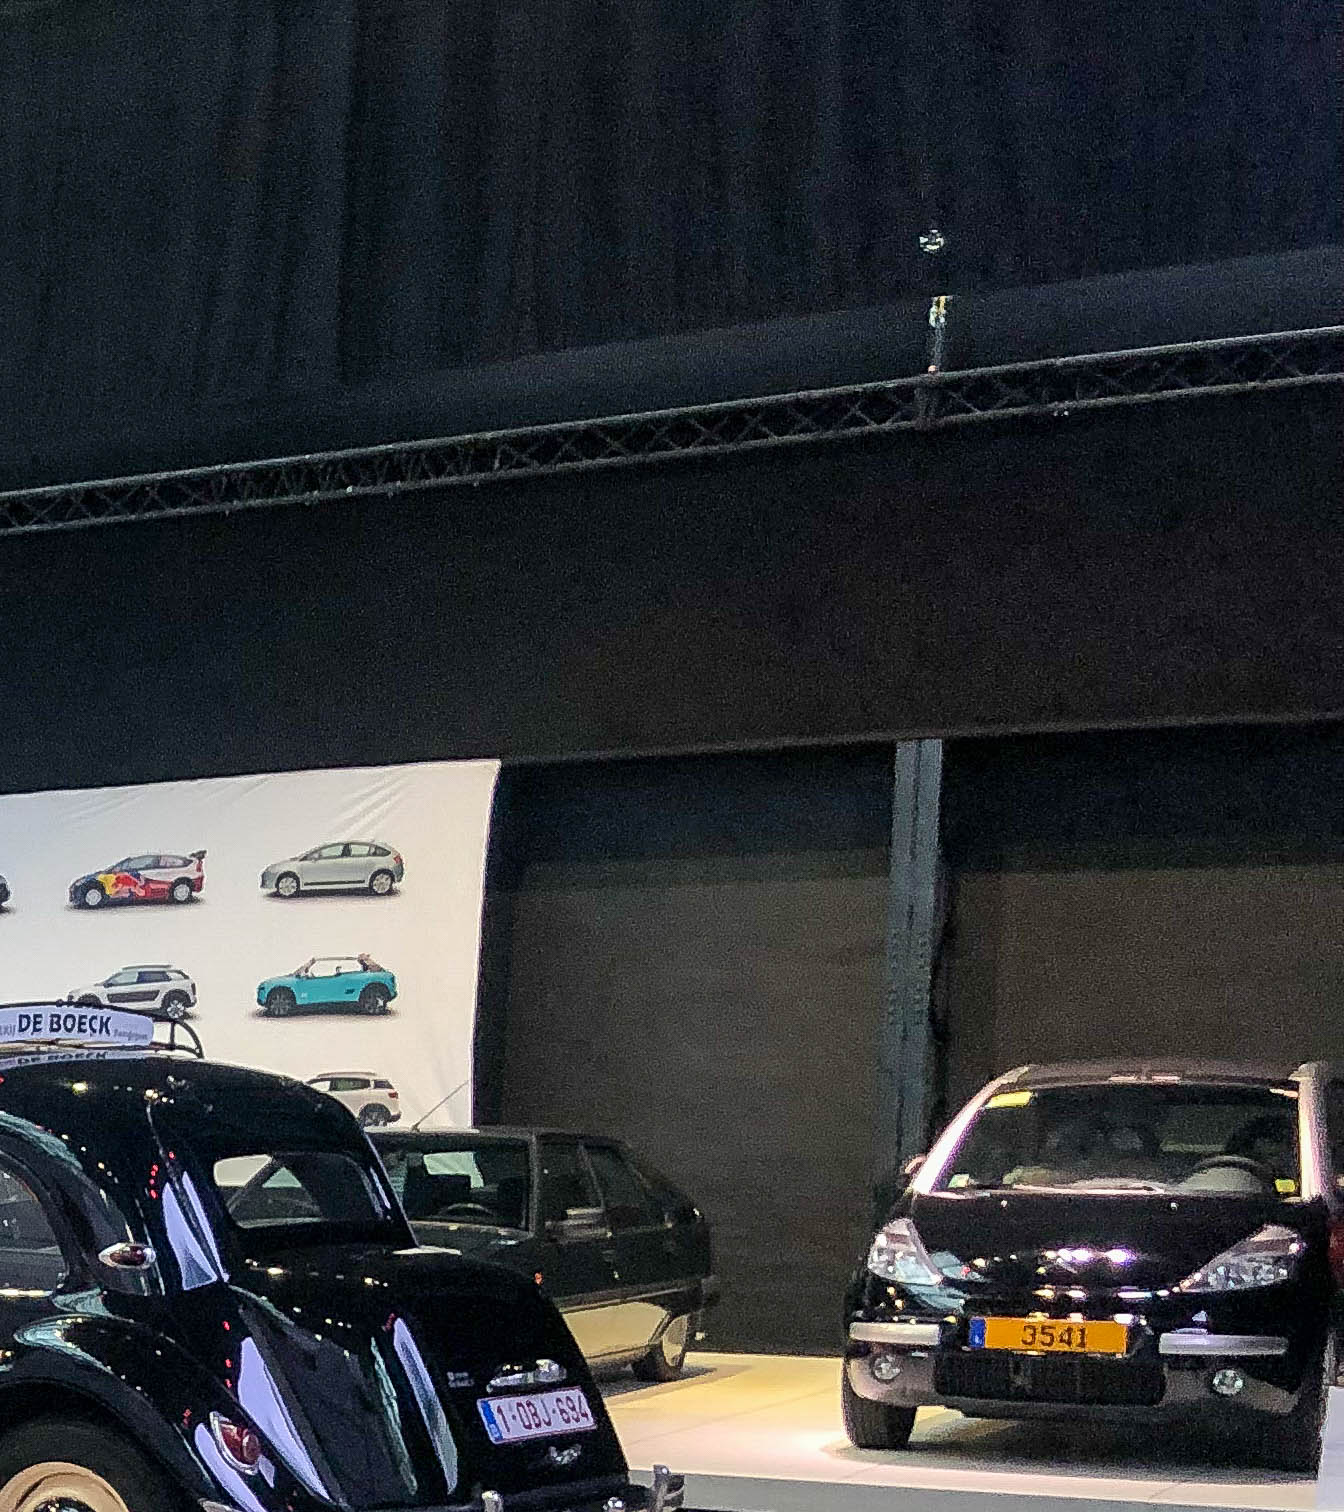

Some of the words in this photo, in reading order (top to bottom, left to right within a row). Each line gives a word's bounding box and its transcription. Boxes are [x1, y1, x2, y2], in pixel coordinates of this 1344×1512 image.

[18, 1014, 43, 1034] DE
[49, 1013, 112, 1036] BOECK
[1020, 1324, 1087, 1349] 3541
